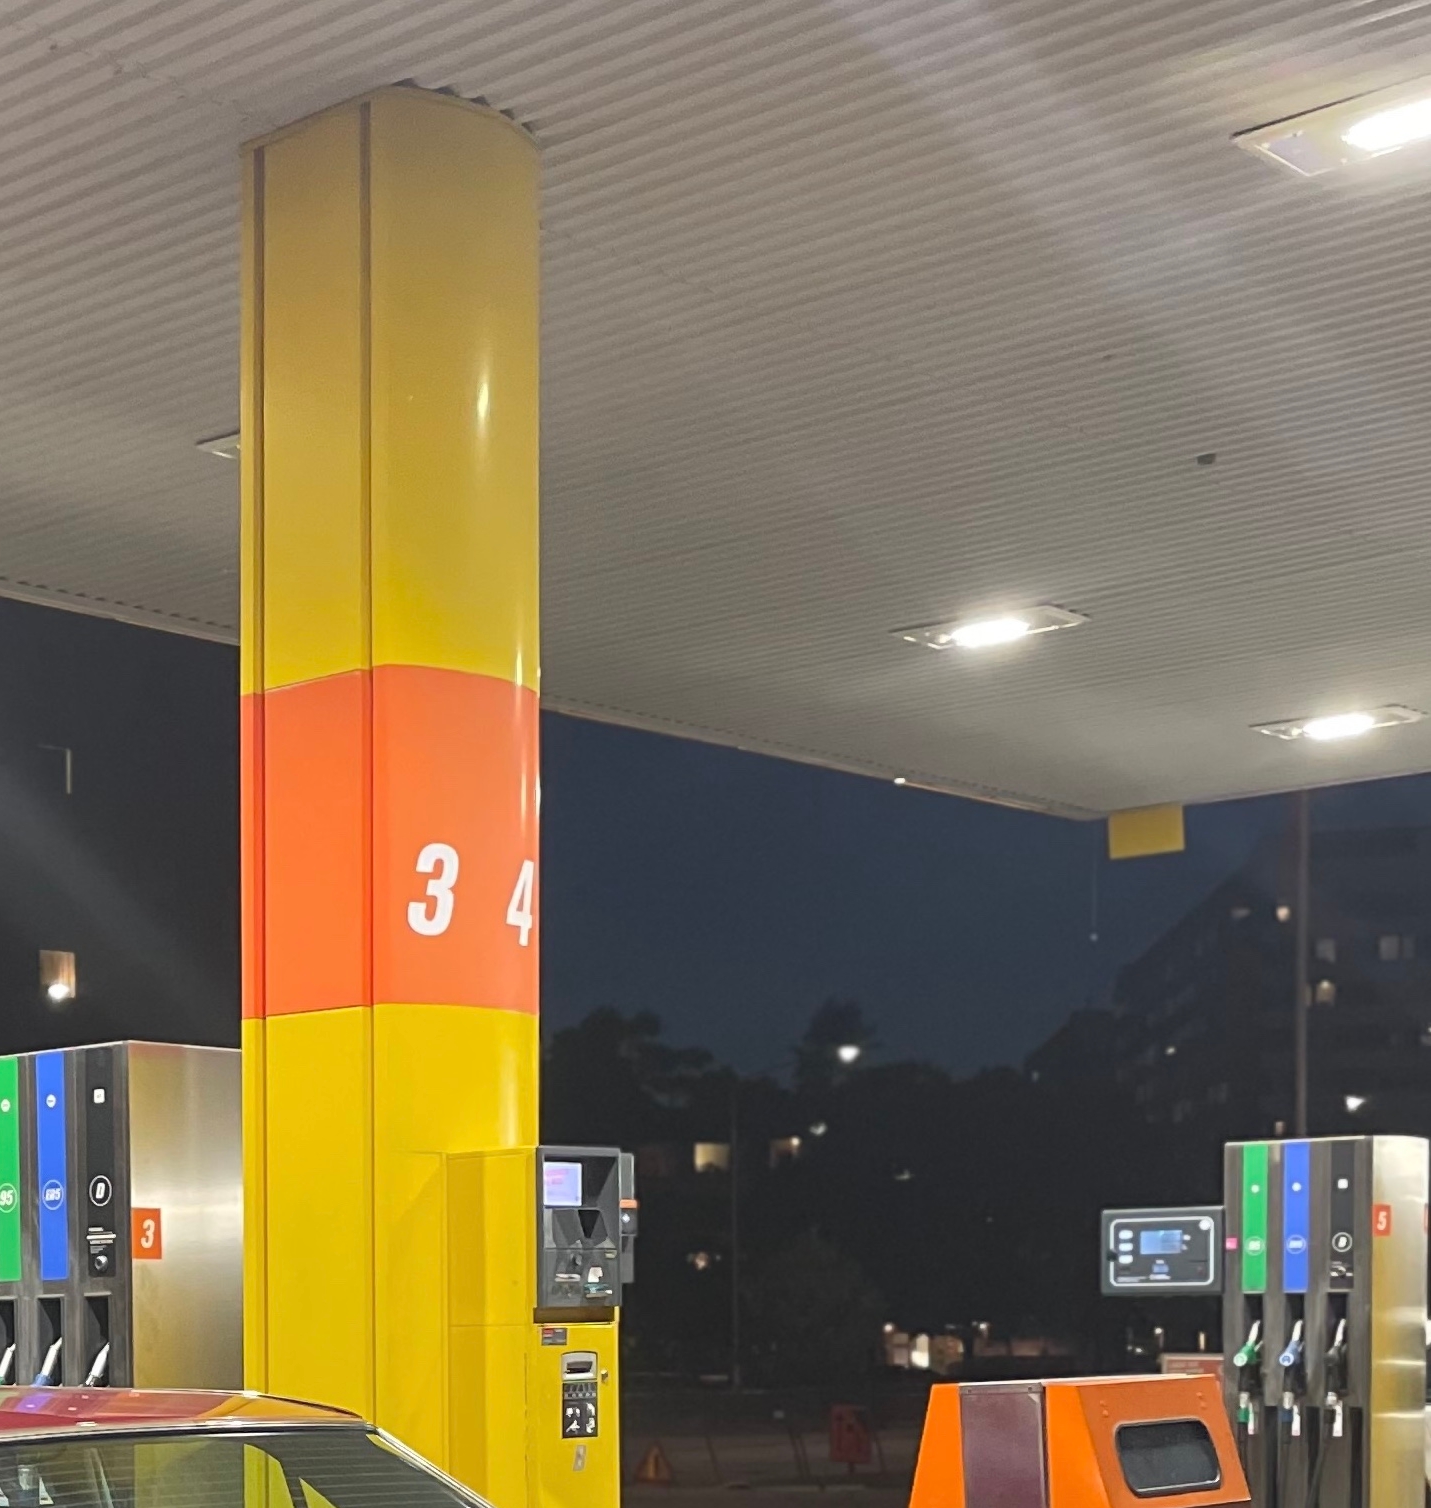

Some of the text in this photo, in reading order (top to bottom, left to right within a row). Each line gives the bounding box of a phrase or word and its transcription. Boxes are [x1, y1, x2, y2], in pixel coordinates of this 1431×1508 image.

[407, 842, 460, 937] 3
[506, 858, 535, 948] 4
[0, 1188, 14, 1206] 95
[141, 1218, 156, 1249] 3
[1376, 1211, 1388, 1231] 5
